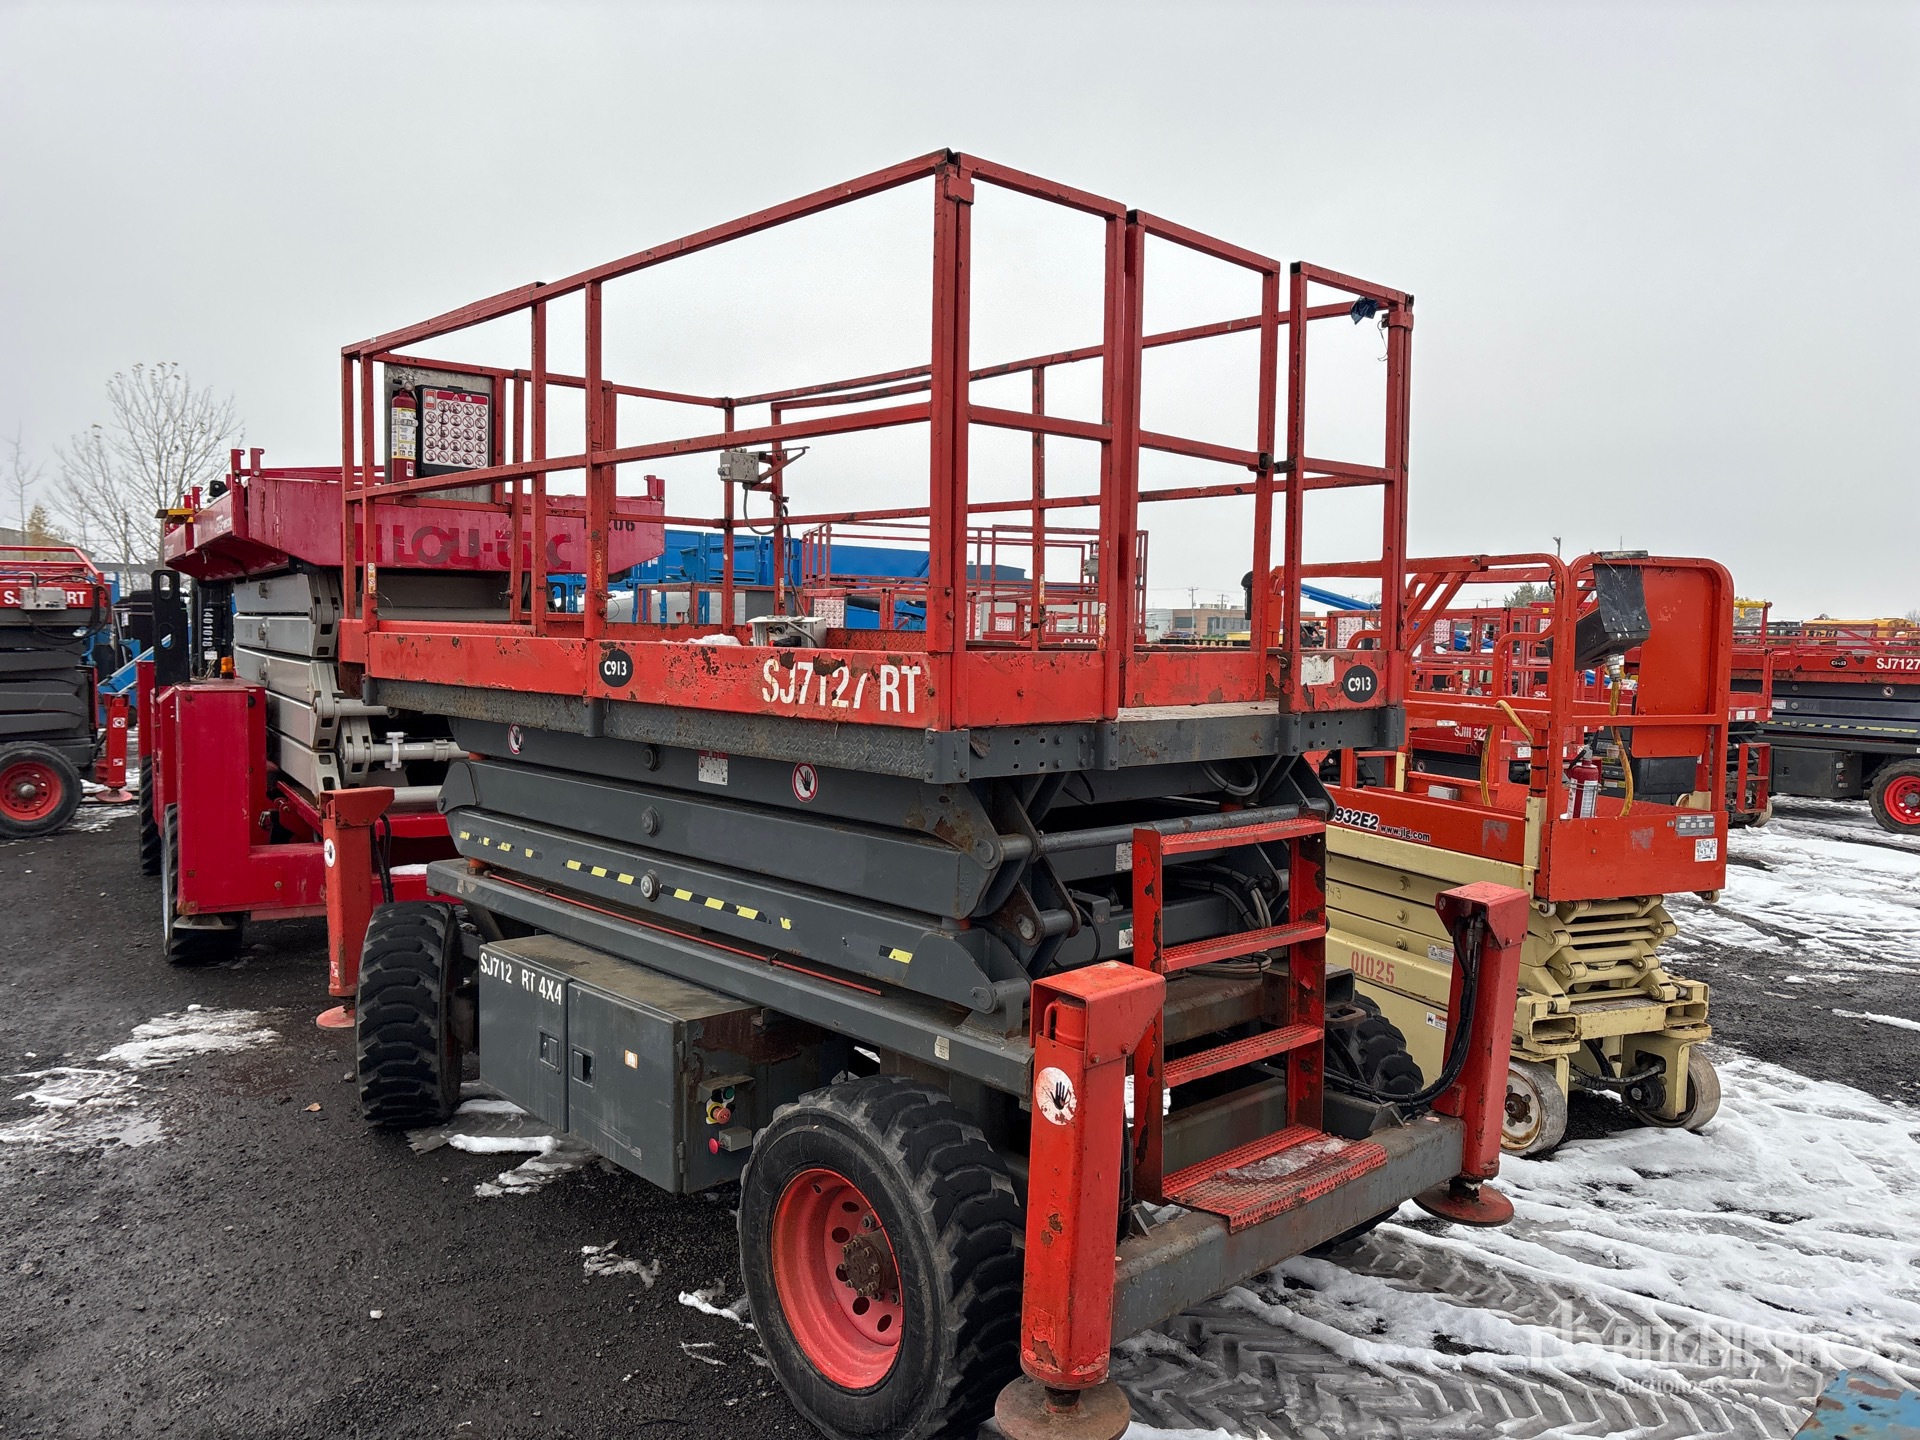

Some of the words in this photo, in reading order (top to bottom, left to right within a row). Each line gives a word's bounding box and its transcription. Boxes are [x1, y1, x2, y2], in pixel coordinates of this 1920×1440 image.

[66, 591, 87, 605] RT
[603, 660, 628, 677] C913
[1348, 676, 1372, 692] C913
[879, 664, 922, 714] RT
[1334, 806, 1380, 831] 932E2
[1380, 825, 1430, 842] www.jlg.com
[480, 952, 512, 984] SJ712
[521, 968, 536, 994] RT
[538, 976, 562, 1006] 4X4
[1351, 950, 1395, 985] 01025
